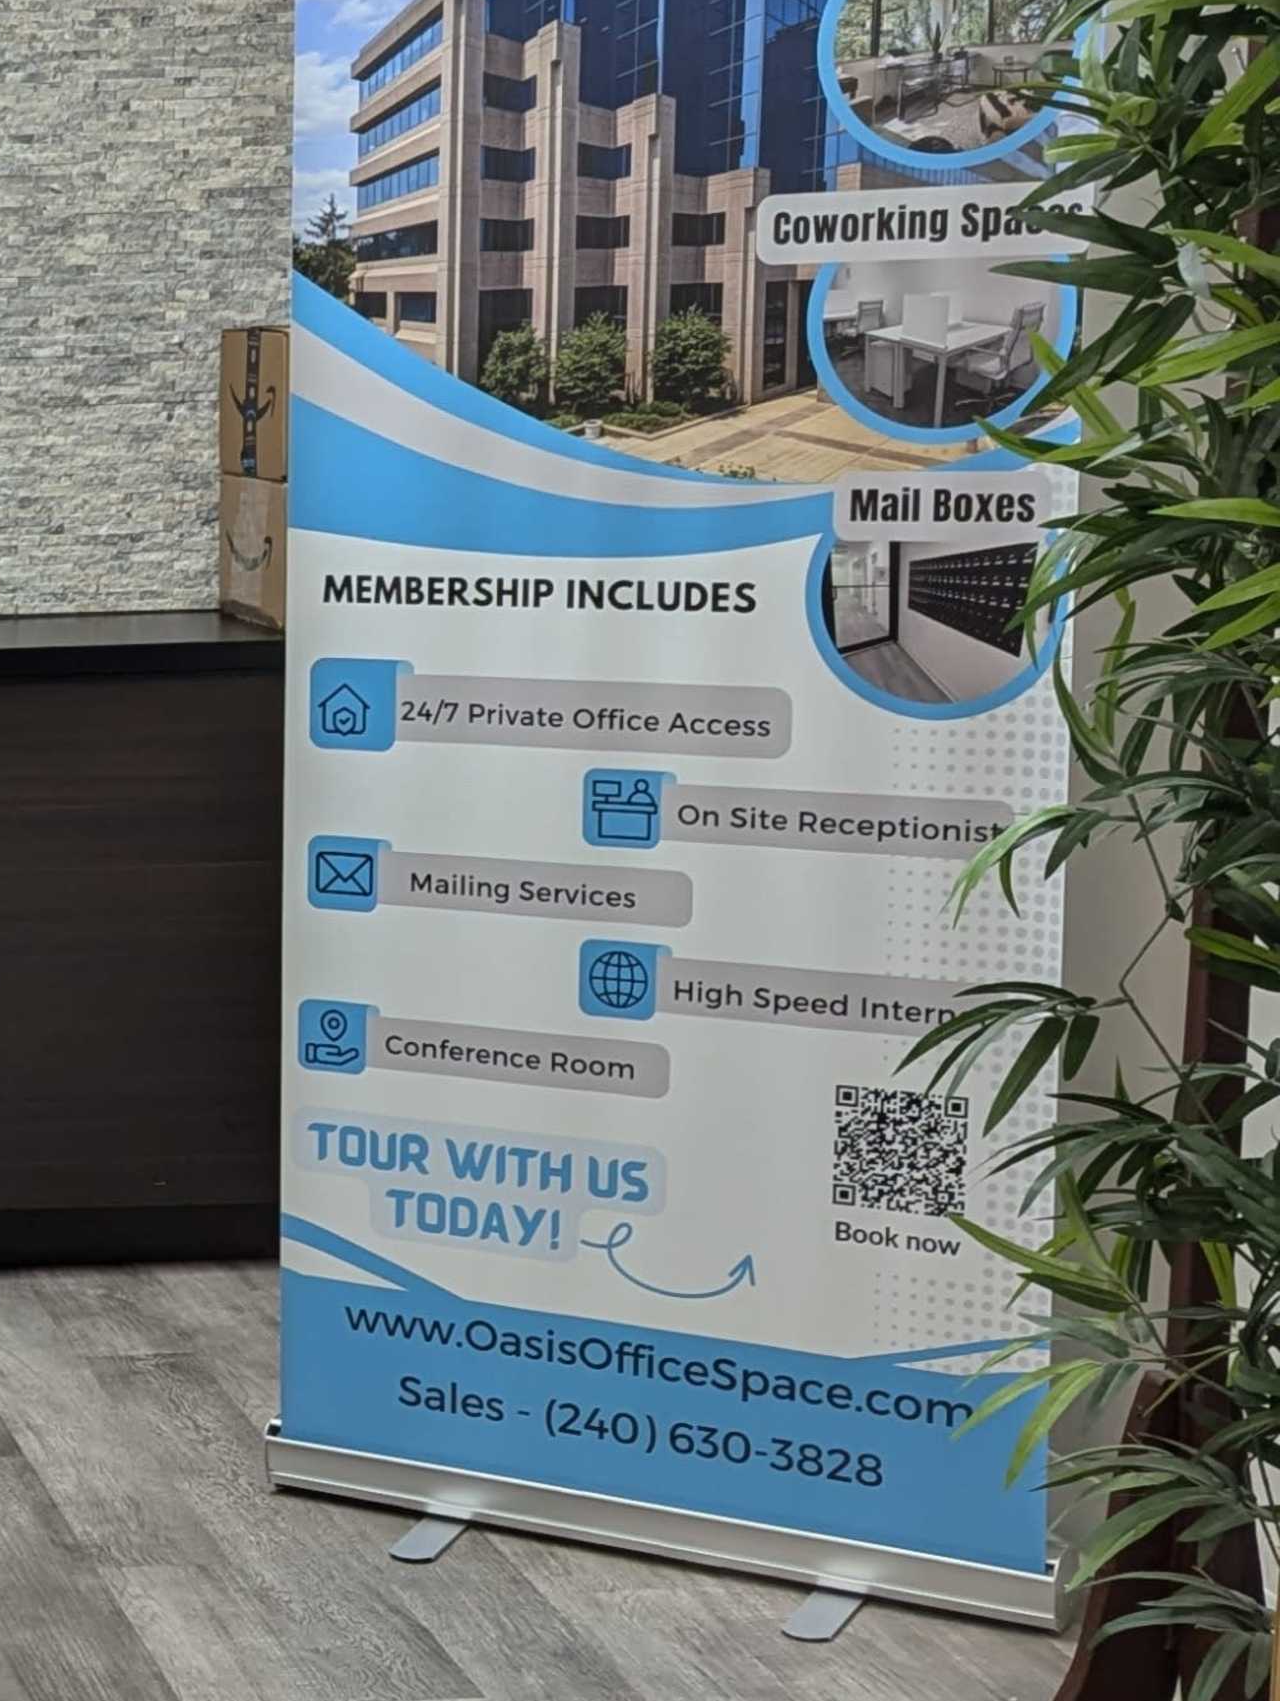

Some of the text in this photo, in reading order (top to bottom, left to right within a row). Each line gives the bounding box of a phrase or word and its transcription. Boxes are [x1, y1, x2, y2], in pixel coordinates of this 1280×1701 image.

[773, 204, 949, 245] Coworking
[850, 487, 1036, 523] Mail Boxes
[322, 574, 758, 614] MEMBERSHIP INCLUDES
[400, 699, 771, 737] 24/7 Private Office Access
[677, 804, 1005, 843] On Site Receptionist
[410, 872, 636, 909] Mailing Services
[674, 980, 743, 1010] High
[753, 986, 849, 1017] Speed
[385, 1035, 636, 1081] Conference Room
[307, 1122, 649, 1202] TOUR WITH US
[385, 1188, 561, 1251] TODAY!
[834, 1220, 961, 1256] Book now
[345, 1304, 974, 1429] www.OasisOfficeSpace.com
[398, 1375, 505, 1423] Sales
[544, 1399, 656, 1454] (240)
[668, 1422, 884, 1488] 630-3828
